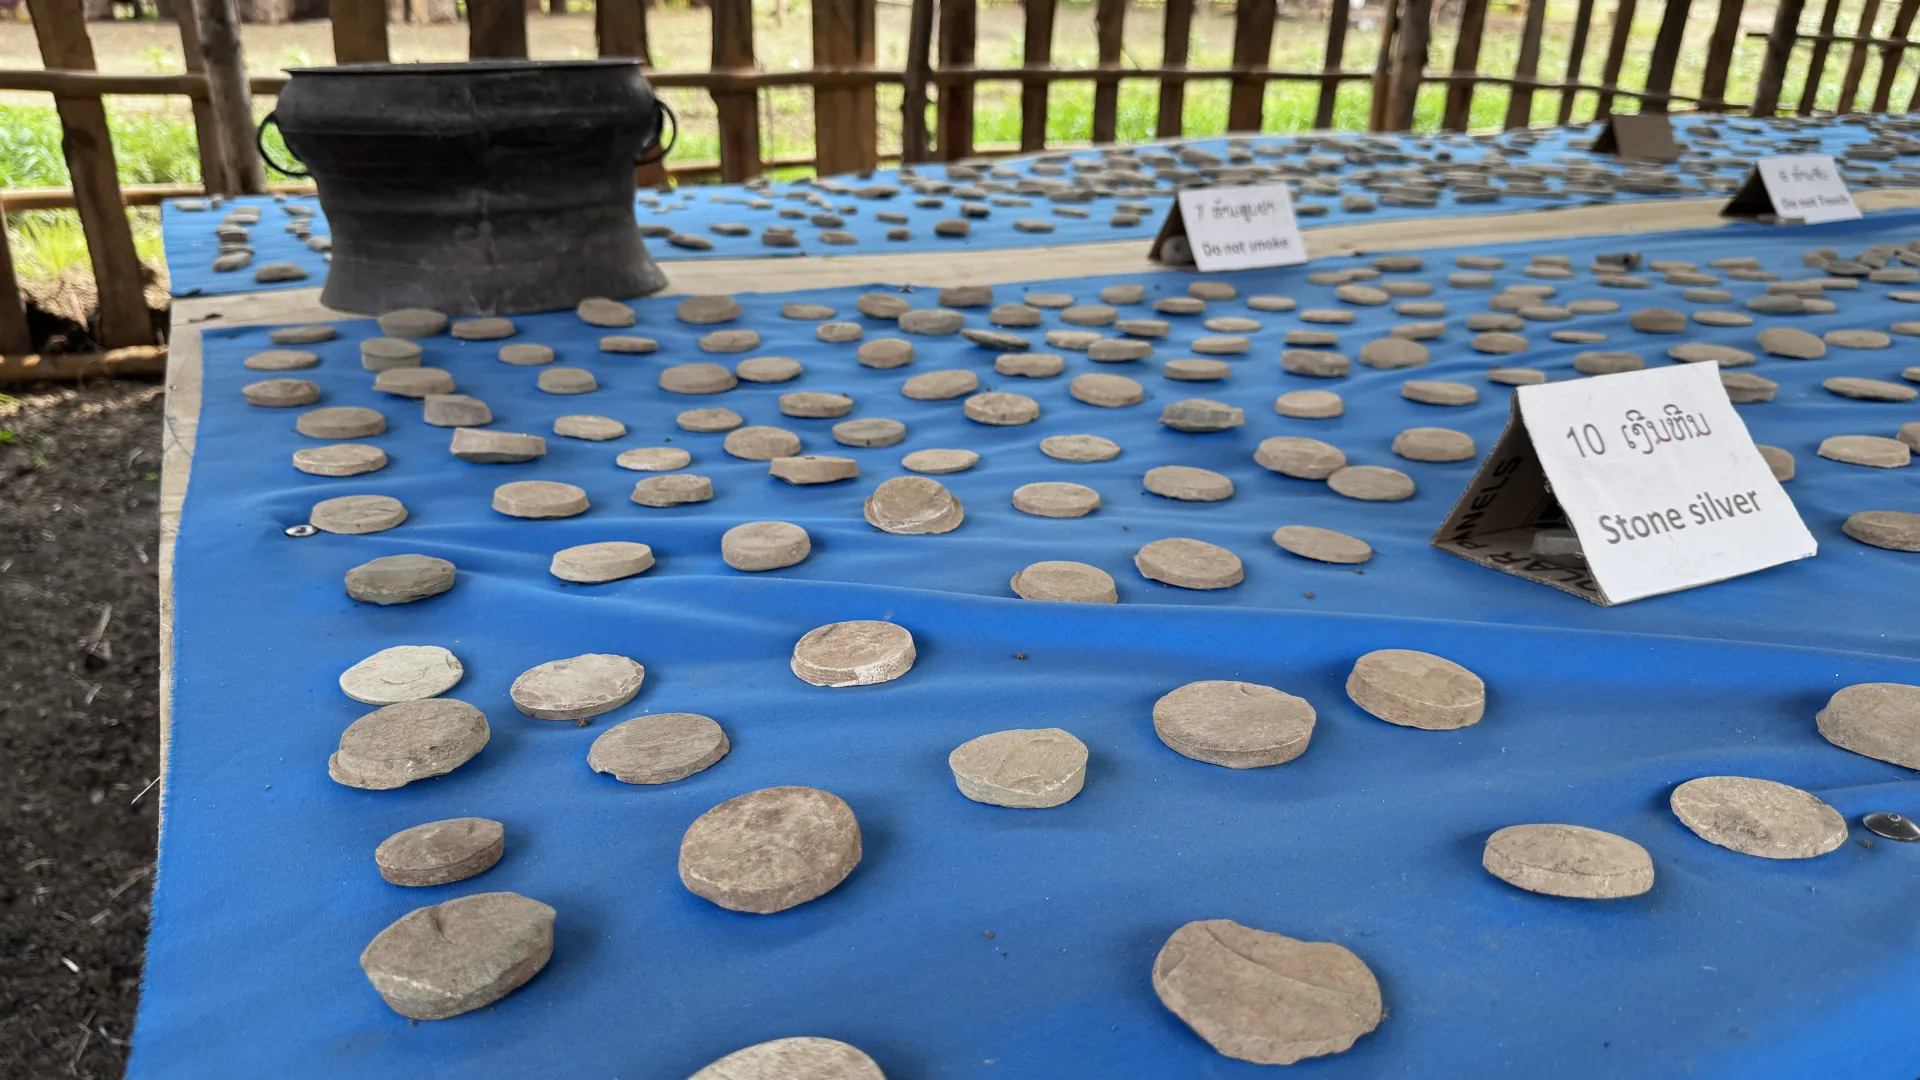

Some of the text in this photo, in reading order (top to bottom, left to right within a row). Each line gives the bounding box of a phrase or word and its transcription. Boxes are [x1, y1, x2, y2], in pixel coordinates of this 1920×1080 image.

[1781, 199, 1799, 210] Do
[1800, 198, 1818, 208] not
[1202, 237, 1288, 258] Do not smoke
[1566, 423, 1605, 458] 10
[1452, 456, 1597, 592] OLAR PANELS
[1598, 490, 1761, 544] Stone silver
